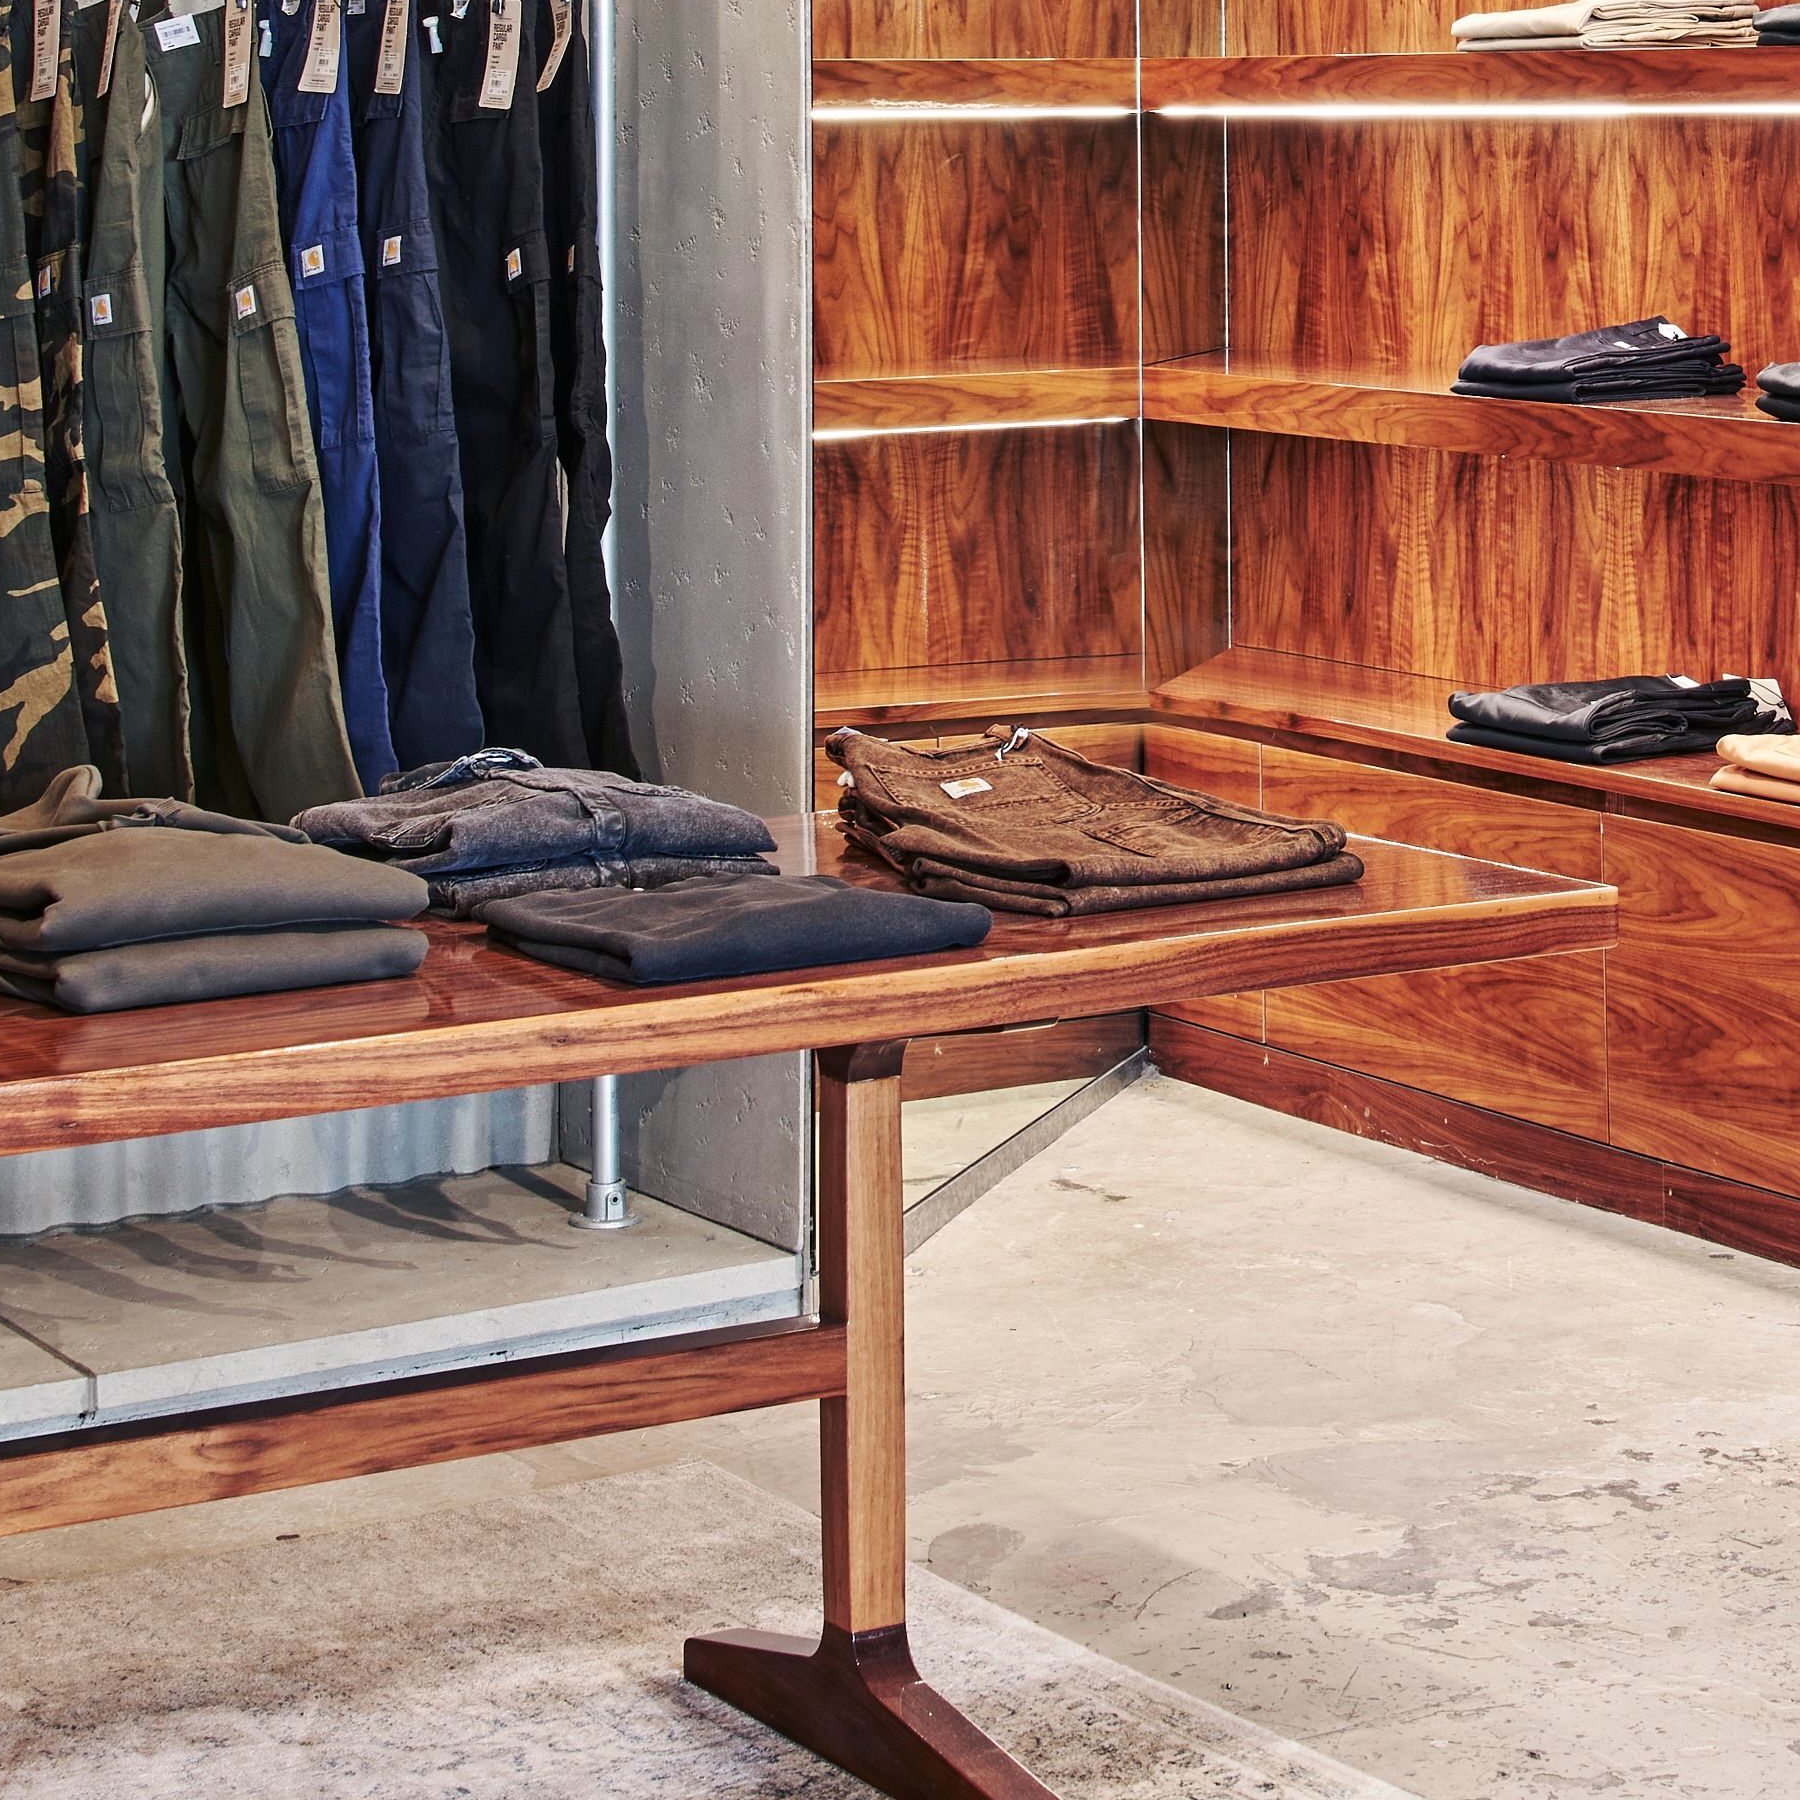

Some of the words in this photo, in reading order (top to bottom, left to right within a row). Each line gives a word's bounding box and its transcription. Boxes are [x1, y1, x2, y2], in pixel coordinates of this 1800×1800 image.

[494, 23, 513, 33] REGULAR
[493, 32, 507, 42] CARGO
[492, 42, 504, 51] PANT
